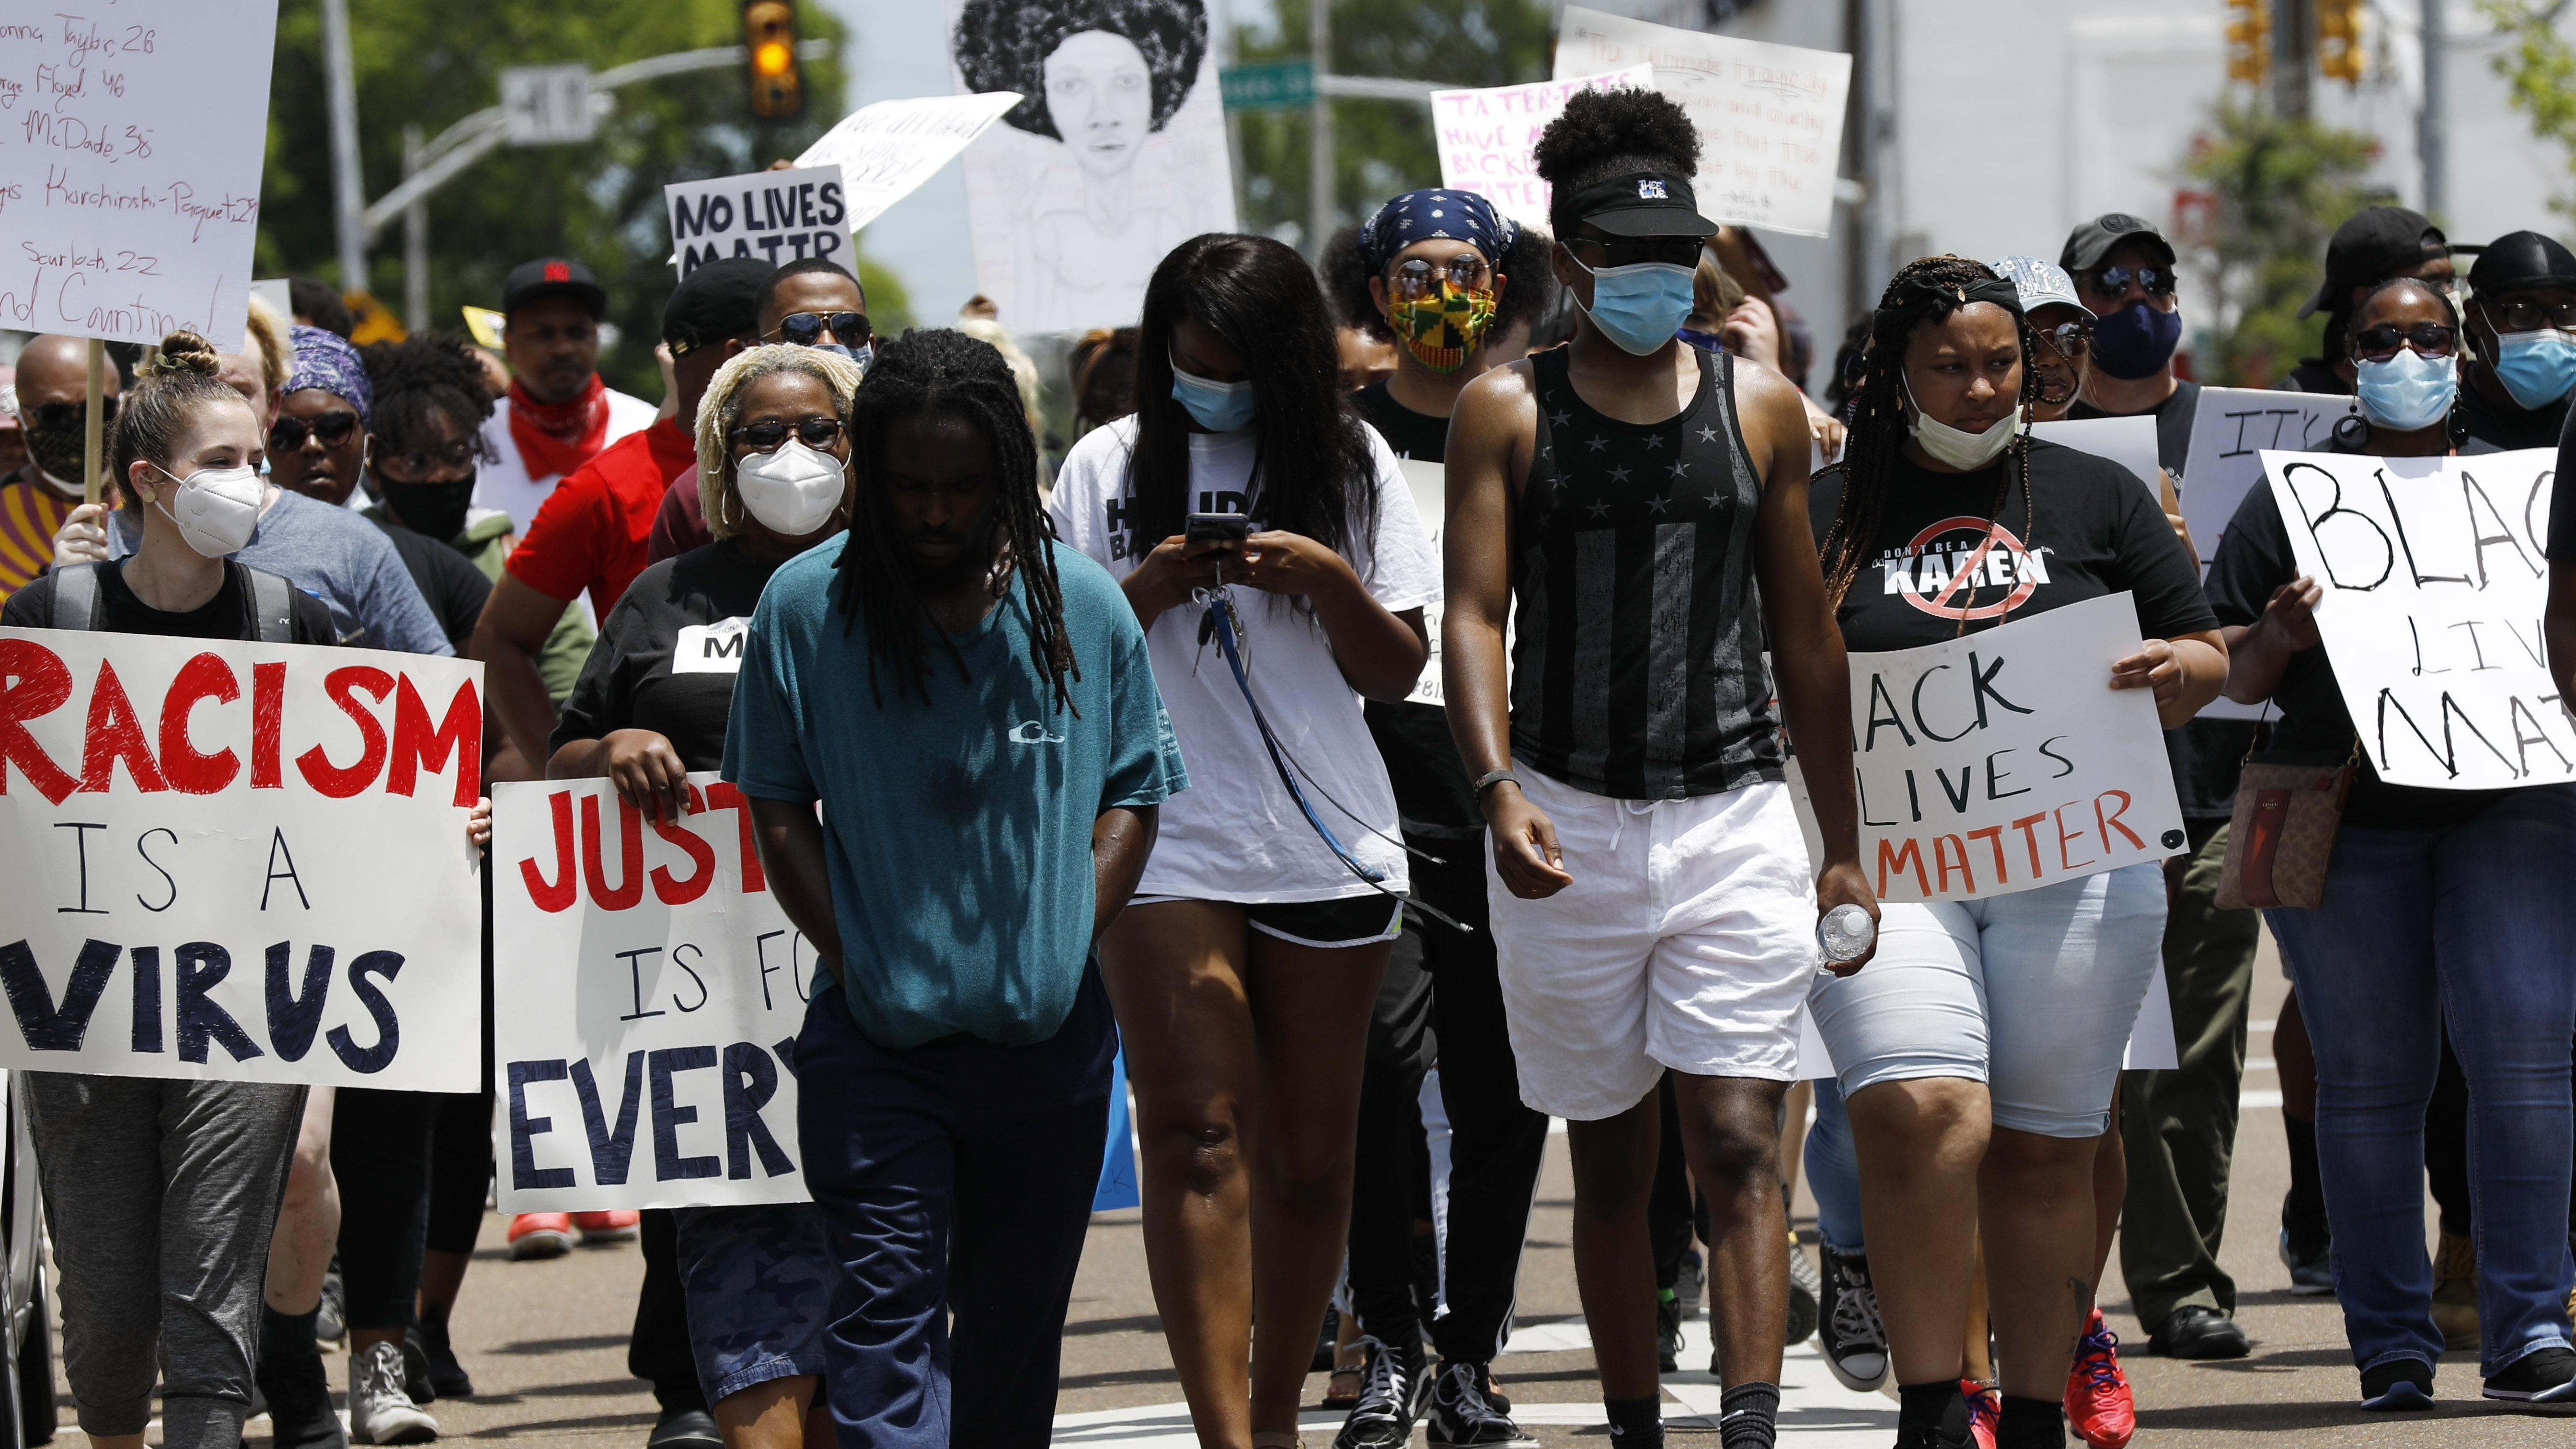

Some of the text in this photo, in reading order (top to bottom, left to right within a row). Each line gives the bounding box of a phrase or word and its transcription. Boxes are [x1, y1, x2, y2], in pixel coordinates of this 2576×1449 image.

[0, 25, 42, 43] onna
[122, 25, 155, 54] 26
[103, 69, 125, 98] 46
[676, 193, 733, 239] NO
[744, 182, 845, 230] LIVES
[1638, 179, 1662, 191] THEE
[0, 267, 42, 328] nd
[117, 252, 161, 276] 22
[1884, 540, 1968, 559] DON'T BE A
[2283, 462, 2555, 592] BLAC
[2408, 615, 2545, 677] LIV
[0, 638, 483, 809] RACISM
[1852, 650, 2036, 753] ACK
[2377, 687, 2576, 780] MAT
[1855, 735, 2075, 827] LIVES
[53, 823, 310, 914] IS A
[518, 782, 767, 913] JUST
[0, 938, 406, 1074] VIRUS
[615, 930, 811, 1022] IS FO
